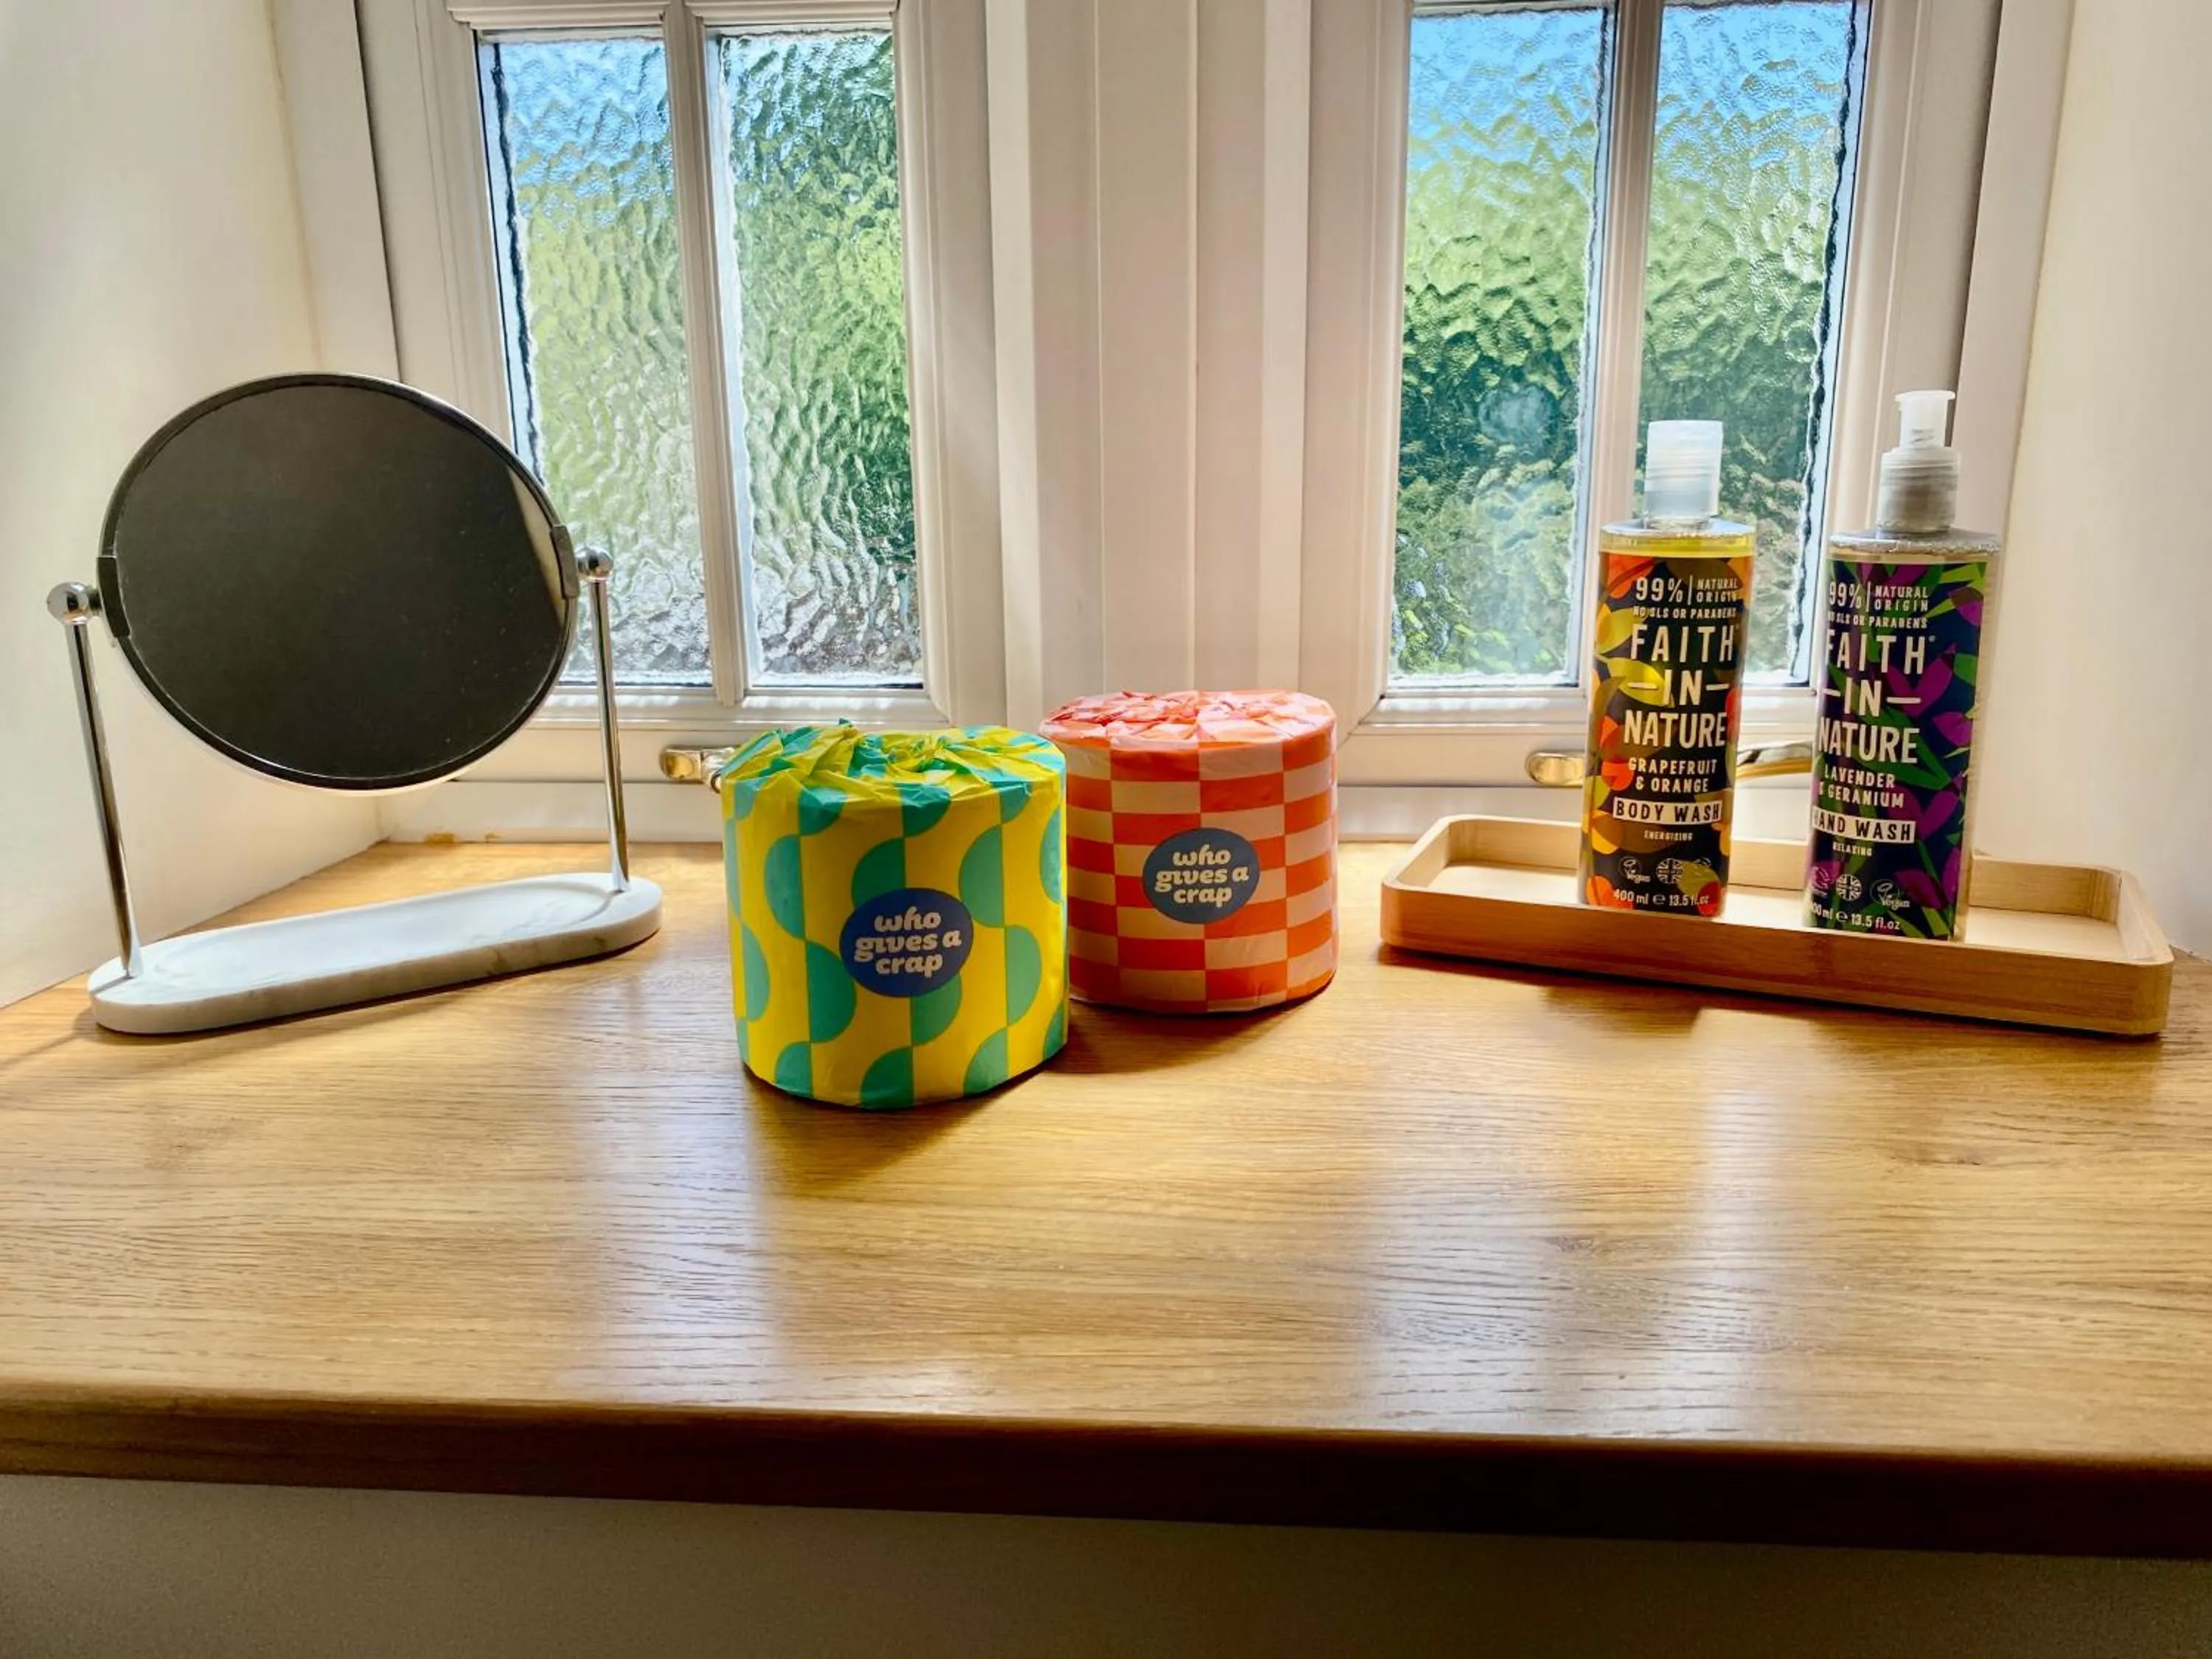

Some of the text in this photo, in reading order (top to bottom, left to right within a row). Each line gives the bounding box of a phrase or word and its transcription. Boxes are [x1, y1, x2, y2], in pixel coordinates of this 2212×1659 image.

[1635, 577, 1739, 602] 99% NATURAL
[1697, 591, 1737, 602] ORIGIN
[1829, 582, 1929, 609] 99% NATURAL
[1650, 607, 1669, 619] SLS
[1672, 606, 1686, 619] OR
[1690, 608, 1736, 619] PARABENS
[1874, 599, 1929, 612] ORIGIN
[1853, 615, 1865, 626] OR
[1869, 616, 1928, 630] PARABENS
[1630, 624, 1733, 663] FAITH
[1825, 629, 1925, 675] FAITH
[1663, 669, 1703, 706] IN
[1844, 677, 1882, 717] IN
[1624, 709, 1728, 748] NATURE
[1818, 716, 1920, 764] NATURE
[1627, 757, 1717, 775] GRAPEFRUIT
[1825, 764, 1895, 788] LAVENDER
[1635, 777, 1709, 793] & ORANGE
[1828, 786, 1905, 809] GERANIUM
[1616, 800, 1721, 823] BODY WASH
[1856, 820, 1910, 841] WASH
[1172, 844, 1231, 866] who
[1832, 841, 1872, 856] RELAXING
[1154, 866, 1250, 892] gives a
[1173, 886, 1232, 908] crap
[1614, 888, 1634, 902] 400
[1636, 892, 1649, 905] ml
[1669, 894, 1690, 906] 13.5
[1880, 894, 1910, 911] Vegan
[874, 906, 942, 932] who
[1811, 902, 1822, 916] 00
[1822, 908, 1832, 919] ml
[1851, 913, 1872, 927] 13.5
[1875, 917, 1900, 931] fl.oz
[854, 930, 962, 962] gives a
[876, 953, 943, 978] crap
